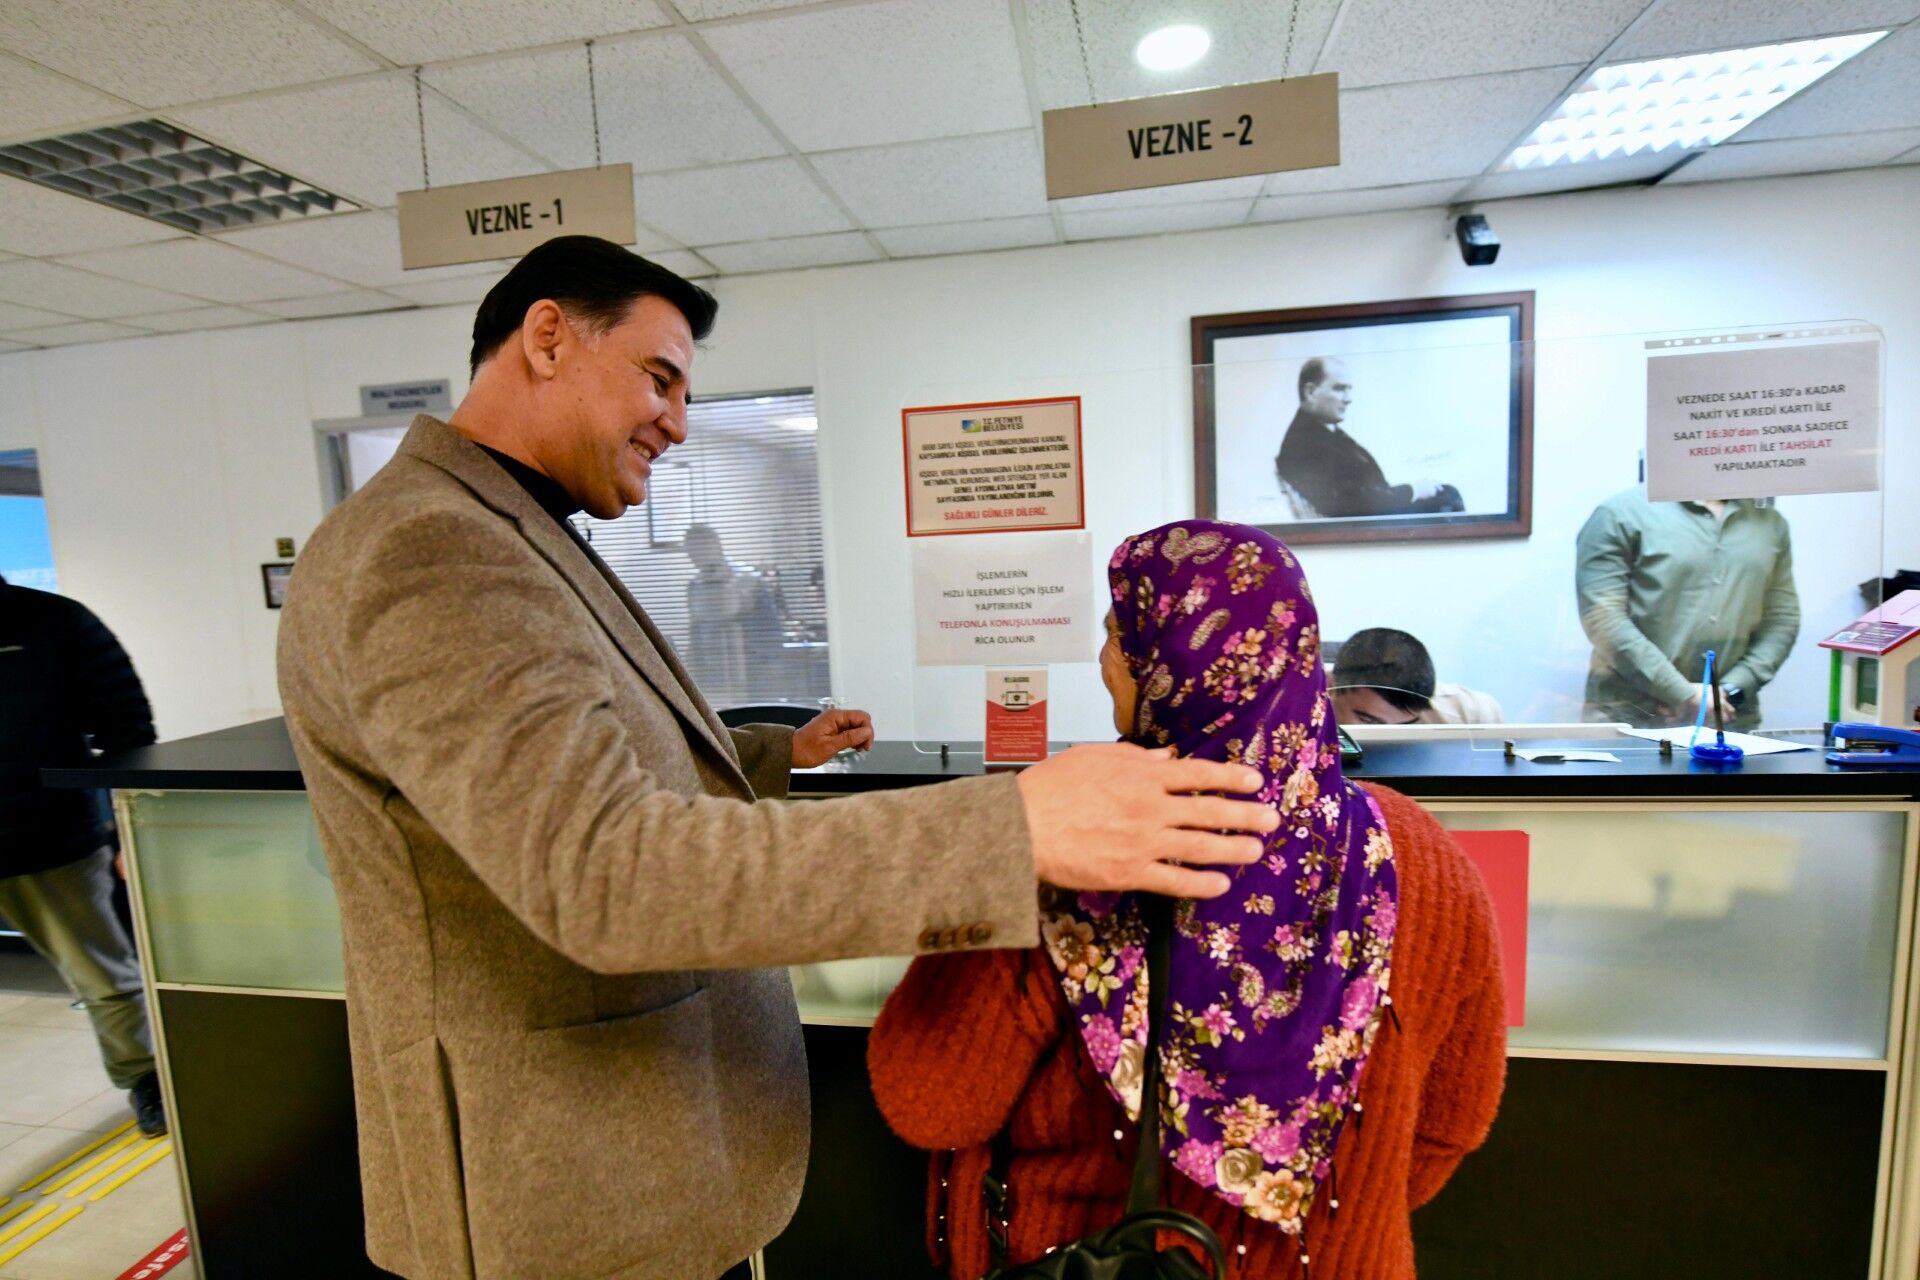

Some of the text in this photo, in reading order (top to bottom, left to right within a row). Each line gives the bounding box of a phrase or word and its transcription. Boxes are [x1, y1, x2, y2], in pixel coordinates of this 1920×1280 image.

[1127, 118, 1212, 159] VEZNE
[465, 202, 533, 236] VEZNE
[1676, 392, 1726, 405] VEZNEDE
[1729, 390, 1758, 402] SAAT
[1805, 384, 1846, 396] KADAR
[1690, 400, 1832, 421] NAKİT VE KREDİ KARTI İLE
[1673, 430, 1703, 442] SAAT
[1762, 423, 1802, 435] SONRA
[1805, 420, 1849, 433] SADECE
[1689, 437, 1833, 457] KREDİ KARTI İLE TAHSİLAT
[1714, 457, 1807, 473] YAPILMAKTADIR
[976, 568, 1028, 581] İŞLEMLERİN
[943, 585, 1065, 598] HIZLI İLERLEMESİ İÇİN İŞLEM
[975, 602, 1032, 611] YAPTIRIRKEN
[939, 616, 1071, 629] TELEFONLA KONUŞULMAMASI
[974, 634, 1036, 645] RİCA OLUNUR
